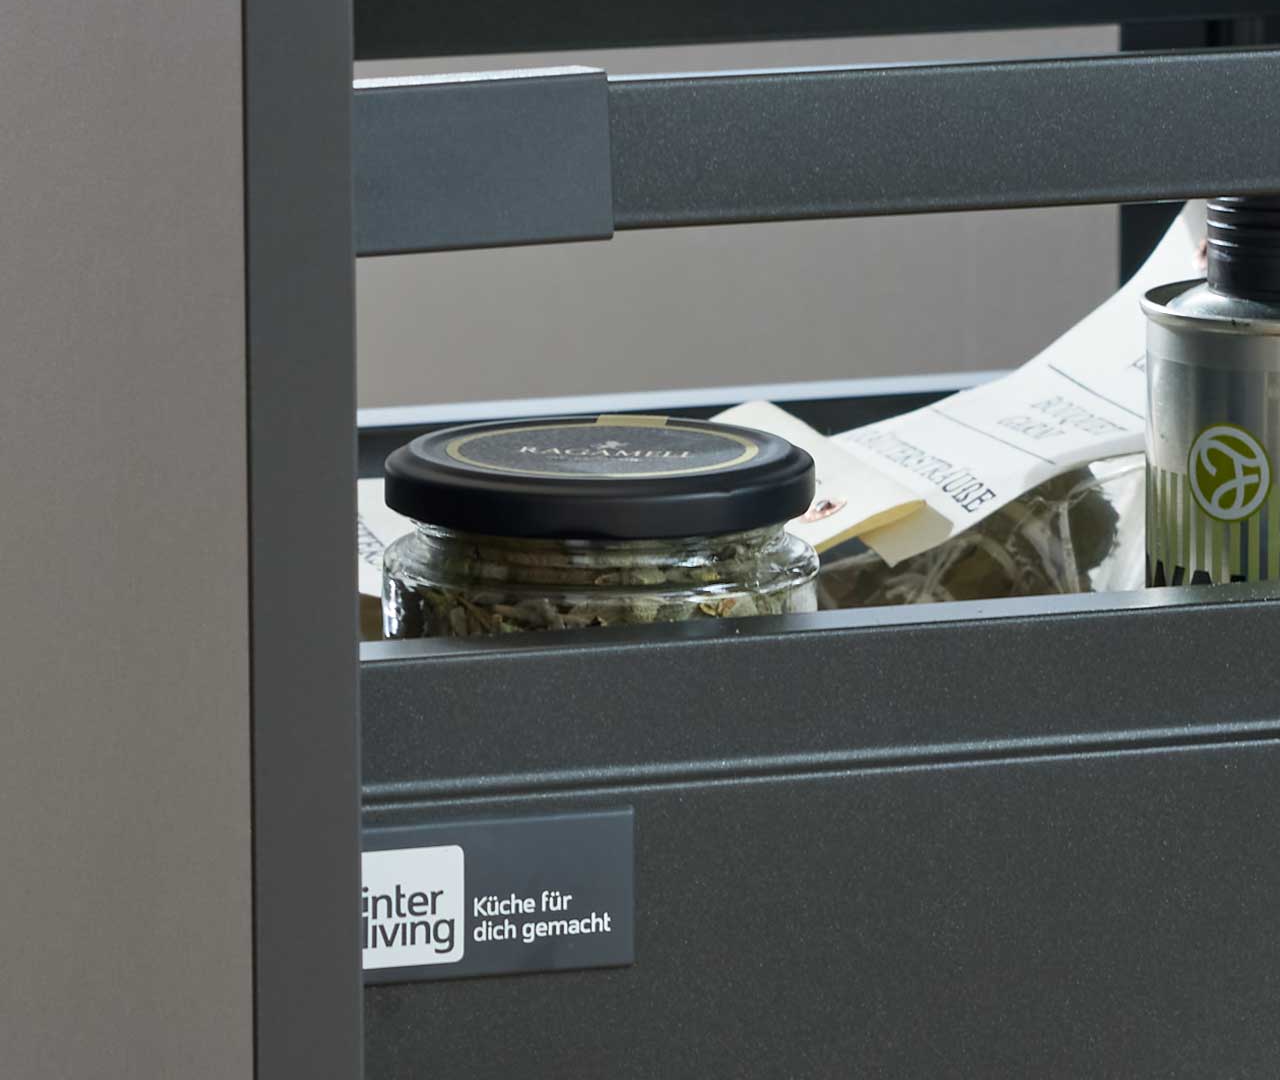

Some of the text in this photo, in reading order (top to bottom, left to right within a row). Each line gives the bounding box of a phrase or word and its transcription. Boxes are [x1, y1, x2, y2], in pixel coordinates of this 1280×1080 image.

[362, 884, 444, 920] inter
[473, 890, 572, 917] Küche für
[362, 916, 455, 954] living
[473, 911, 611, 943] dich gemacht
